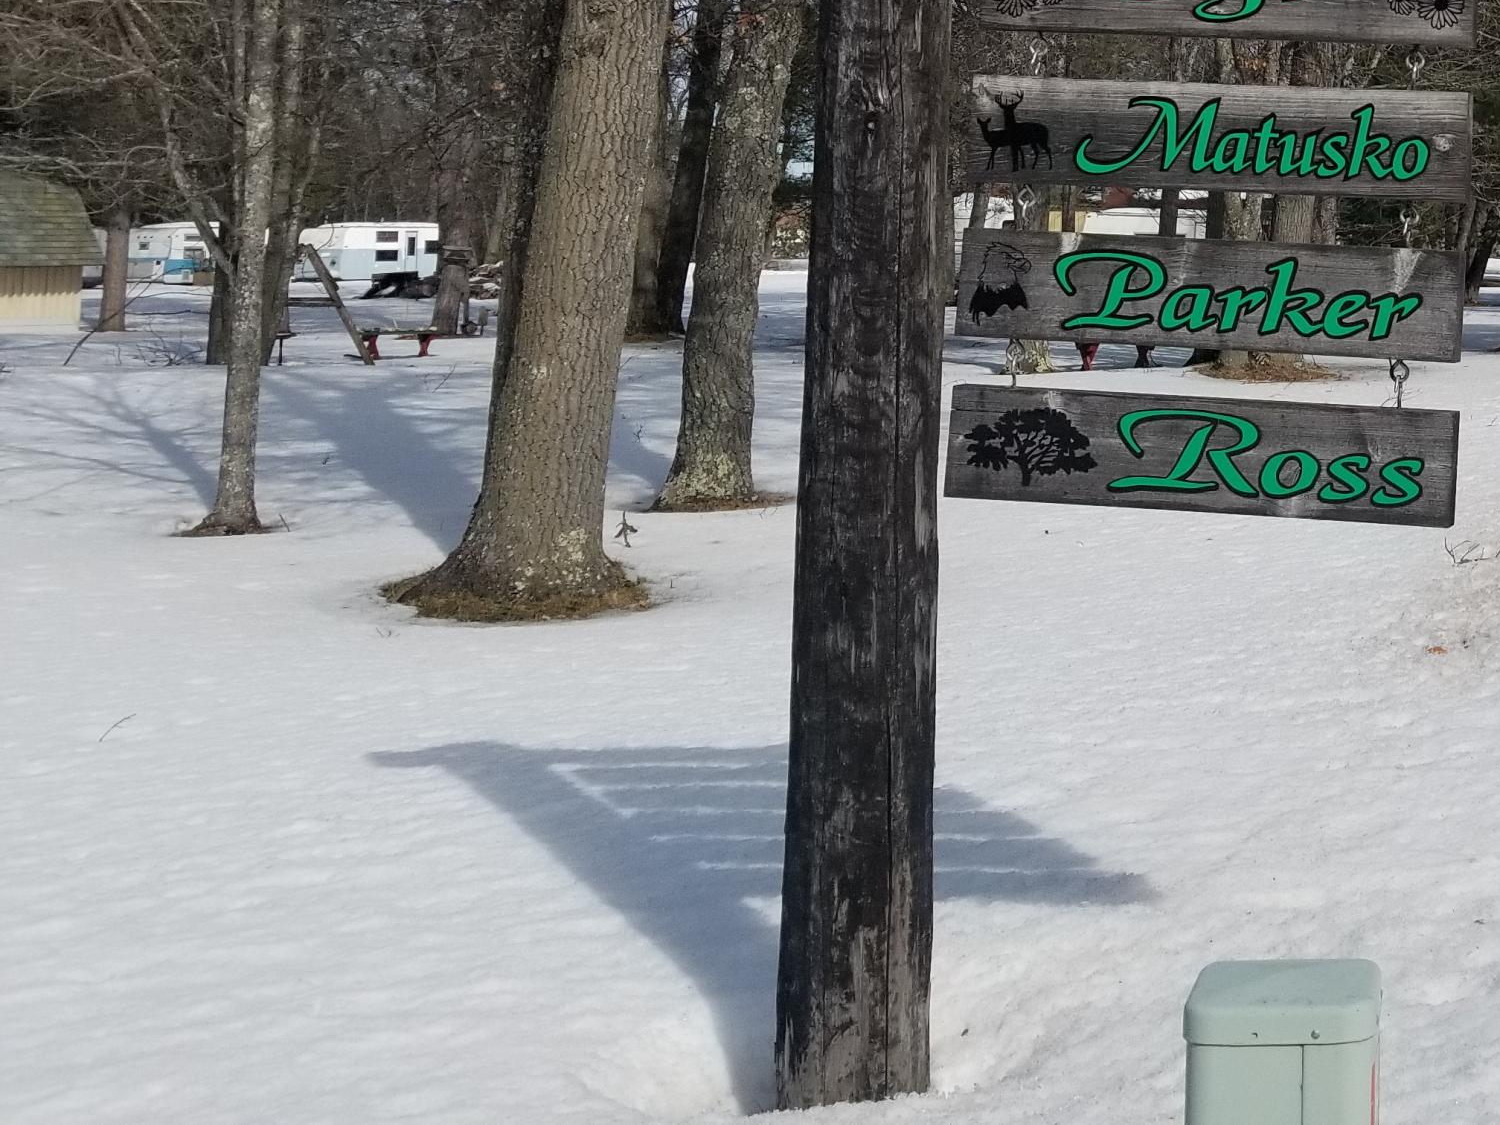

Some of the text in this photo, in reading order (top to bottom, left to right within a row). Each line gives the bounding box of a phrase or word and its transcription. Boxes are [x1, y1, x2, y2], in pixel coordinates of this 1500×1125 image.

[1075, 97, 1430, 181] Matusko
[1054, 251, 1420, 339] Parker
[1108, 408, 1424, 506] Ross
